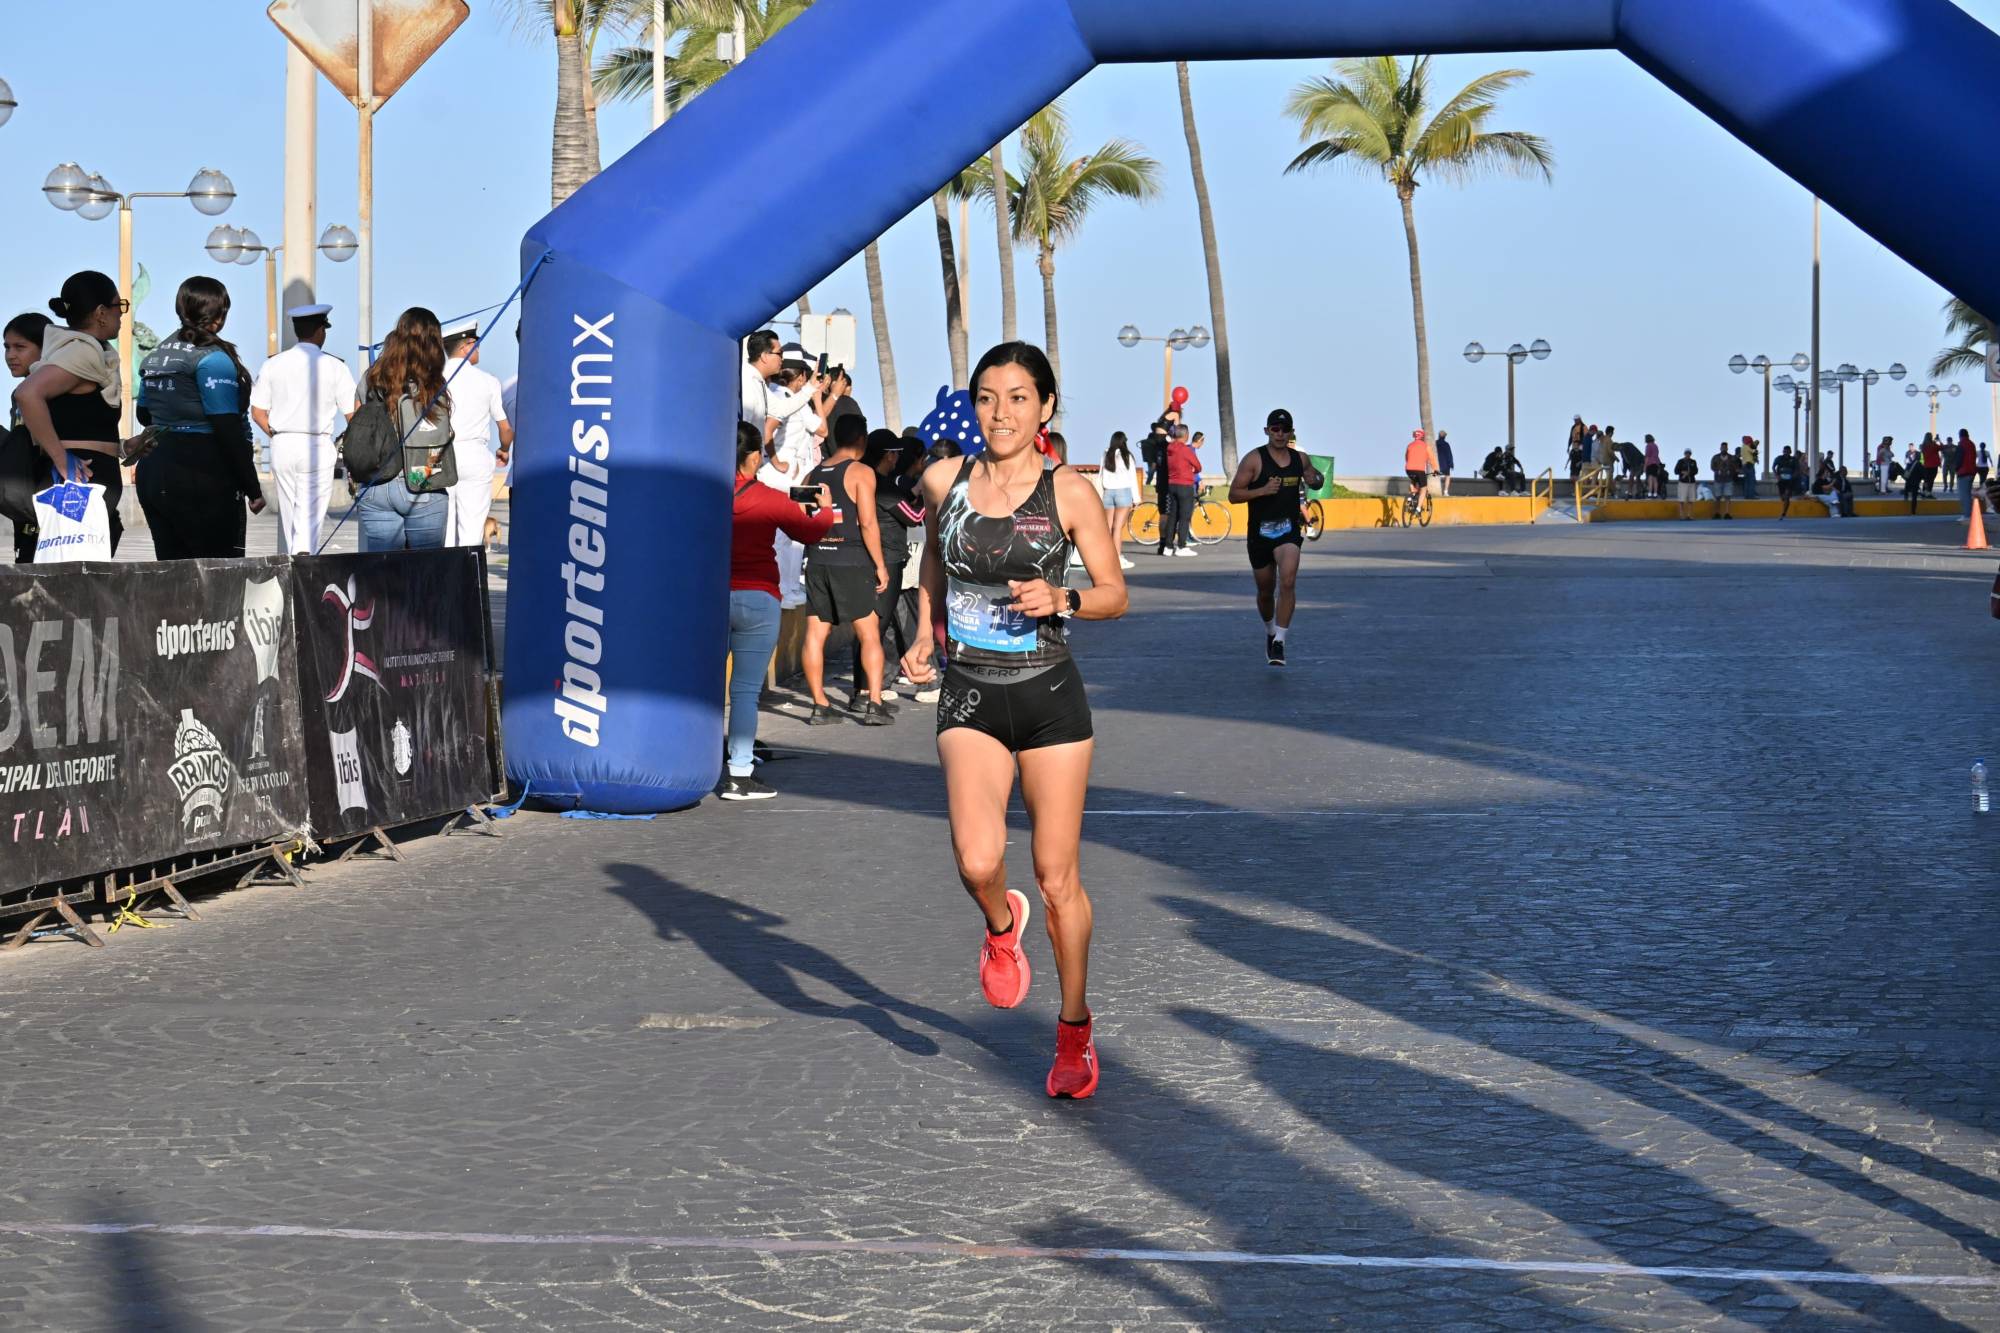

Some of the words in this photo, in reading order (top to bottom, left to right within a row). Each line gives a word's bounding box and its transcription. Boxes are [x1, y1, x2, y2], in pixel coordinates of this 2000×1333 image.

[553, 311, 615, 748] dportenis.mx
[155, 618, 236, 660] dportenis
[45, 761, 65, 789] DEL
[64, 754, 116, 786] DEPORTE
[337, 752, 360, 785] ibis
